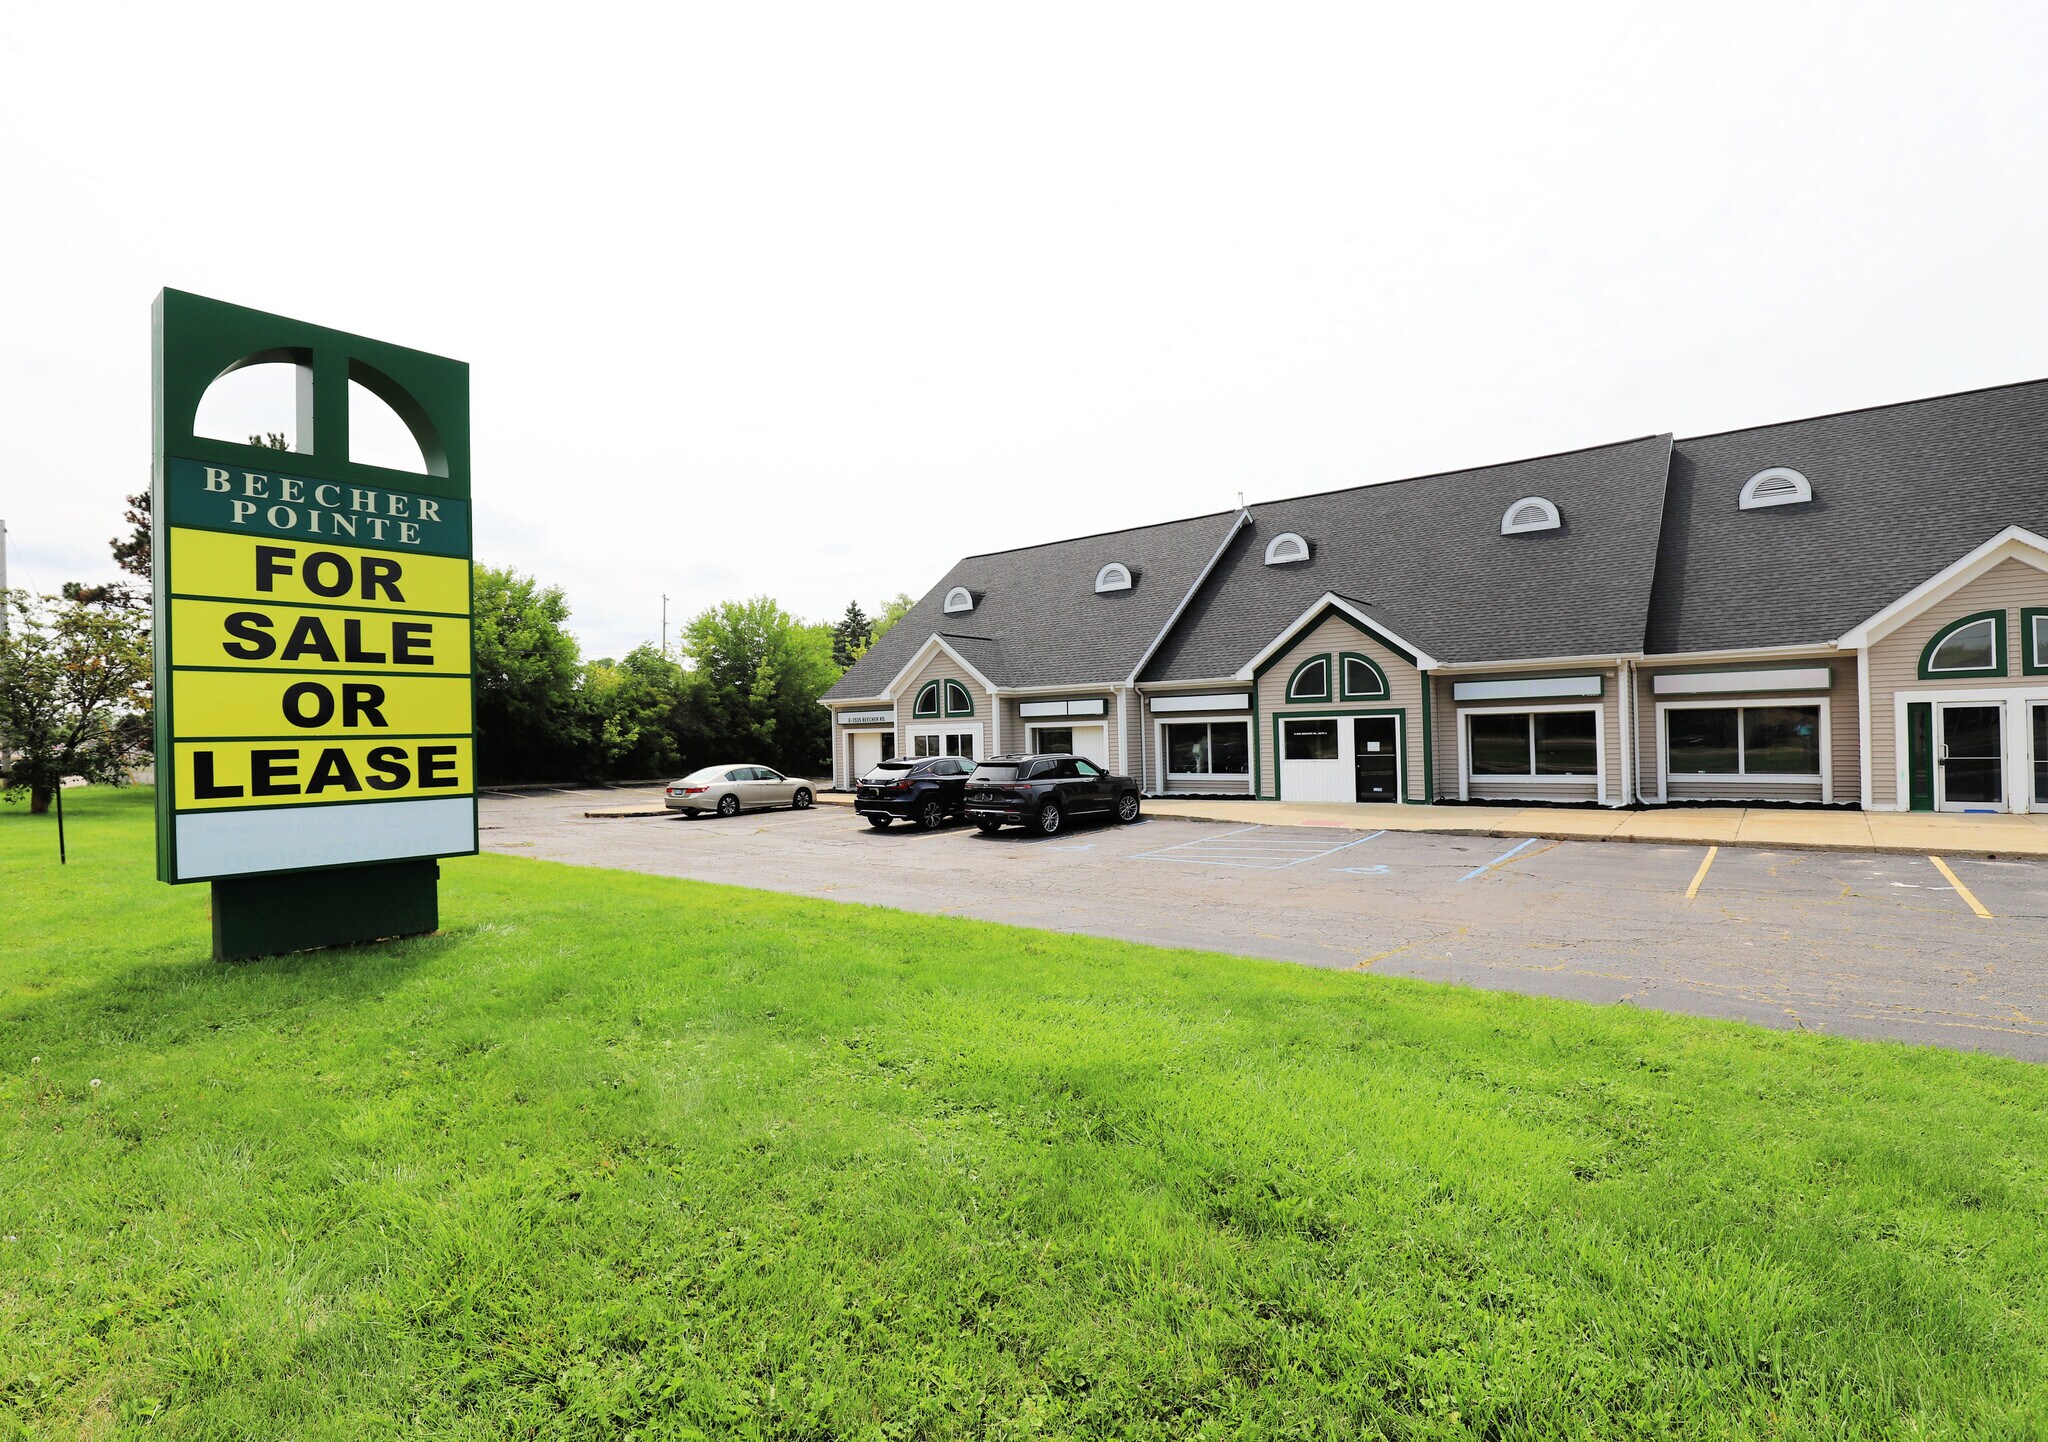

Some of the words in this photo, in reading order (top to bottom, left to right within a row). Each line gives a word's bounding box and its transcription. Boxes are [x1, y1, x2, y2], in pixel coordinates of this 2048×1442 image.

[203, 466, 442, 522] BEECHER
[230, 499, 421, 545] POINTE
[255, 545, 406, 603] FOR
[222, 611, 434, 666] SALE
[282, 681, 389, 728] OR
[193, 745, 459, 800] LEASE
